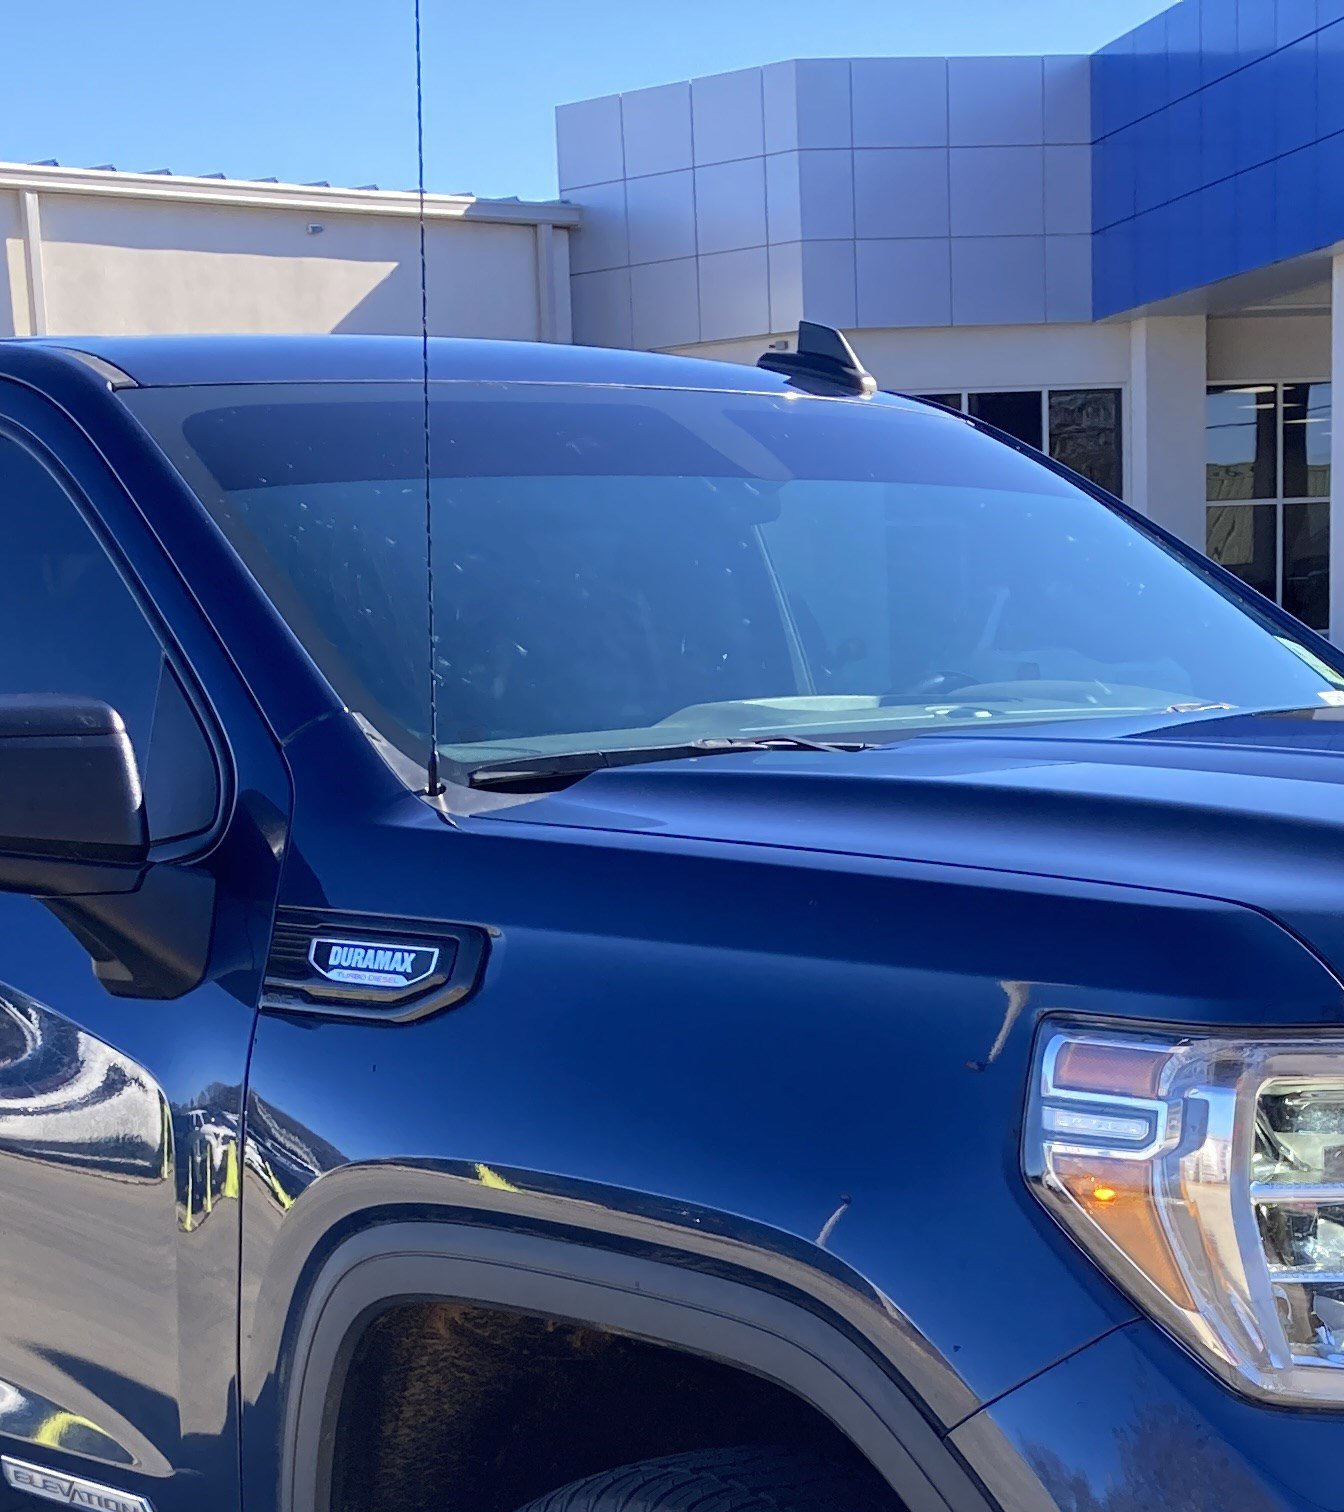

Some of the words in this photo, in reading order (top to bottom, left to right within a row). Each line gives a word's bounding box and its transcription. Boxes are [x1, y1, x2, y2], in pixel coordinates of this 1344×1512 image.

[328, 945, 417, 974] DURAMAX
[337, 972, 367, 981] TURBO
[368, 974, 399, 984] DIESEL
